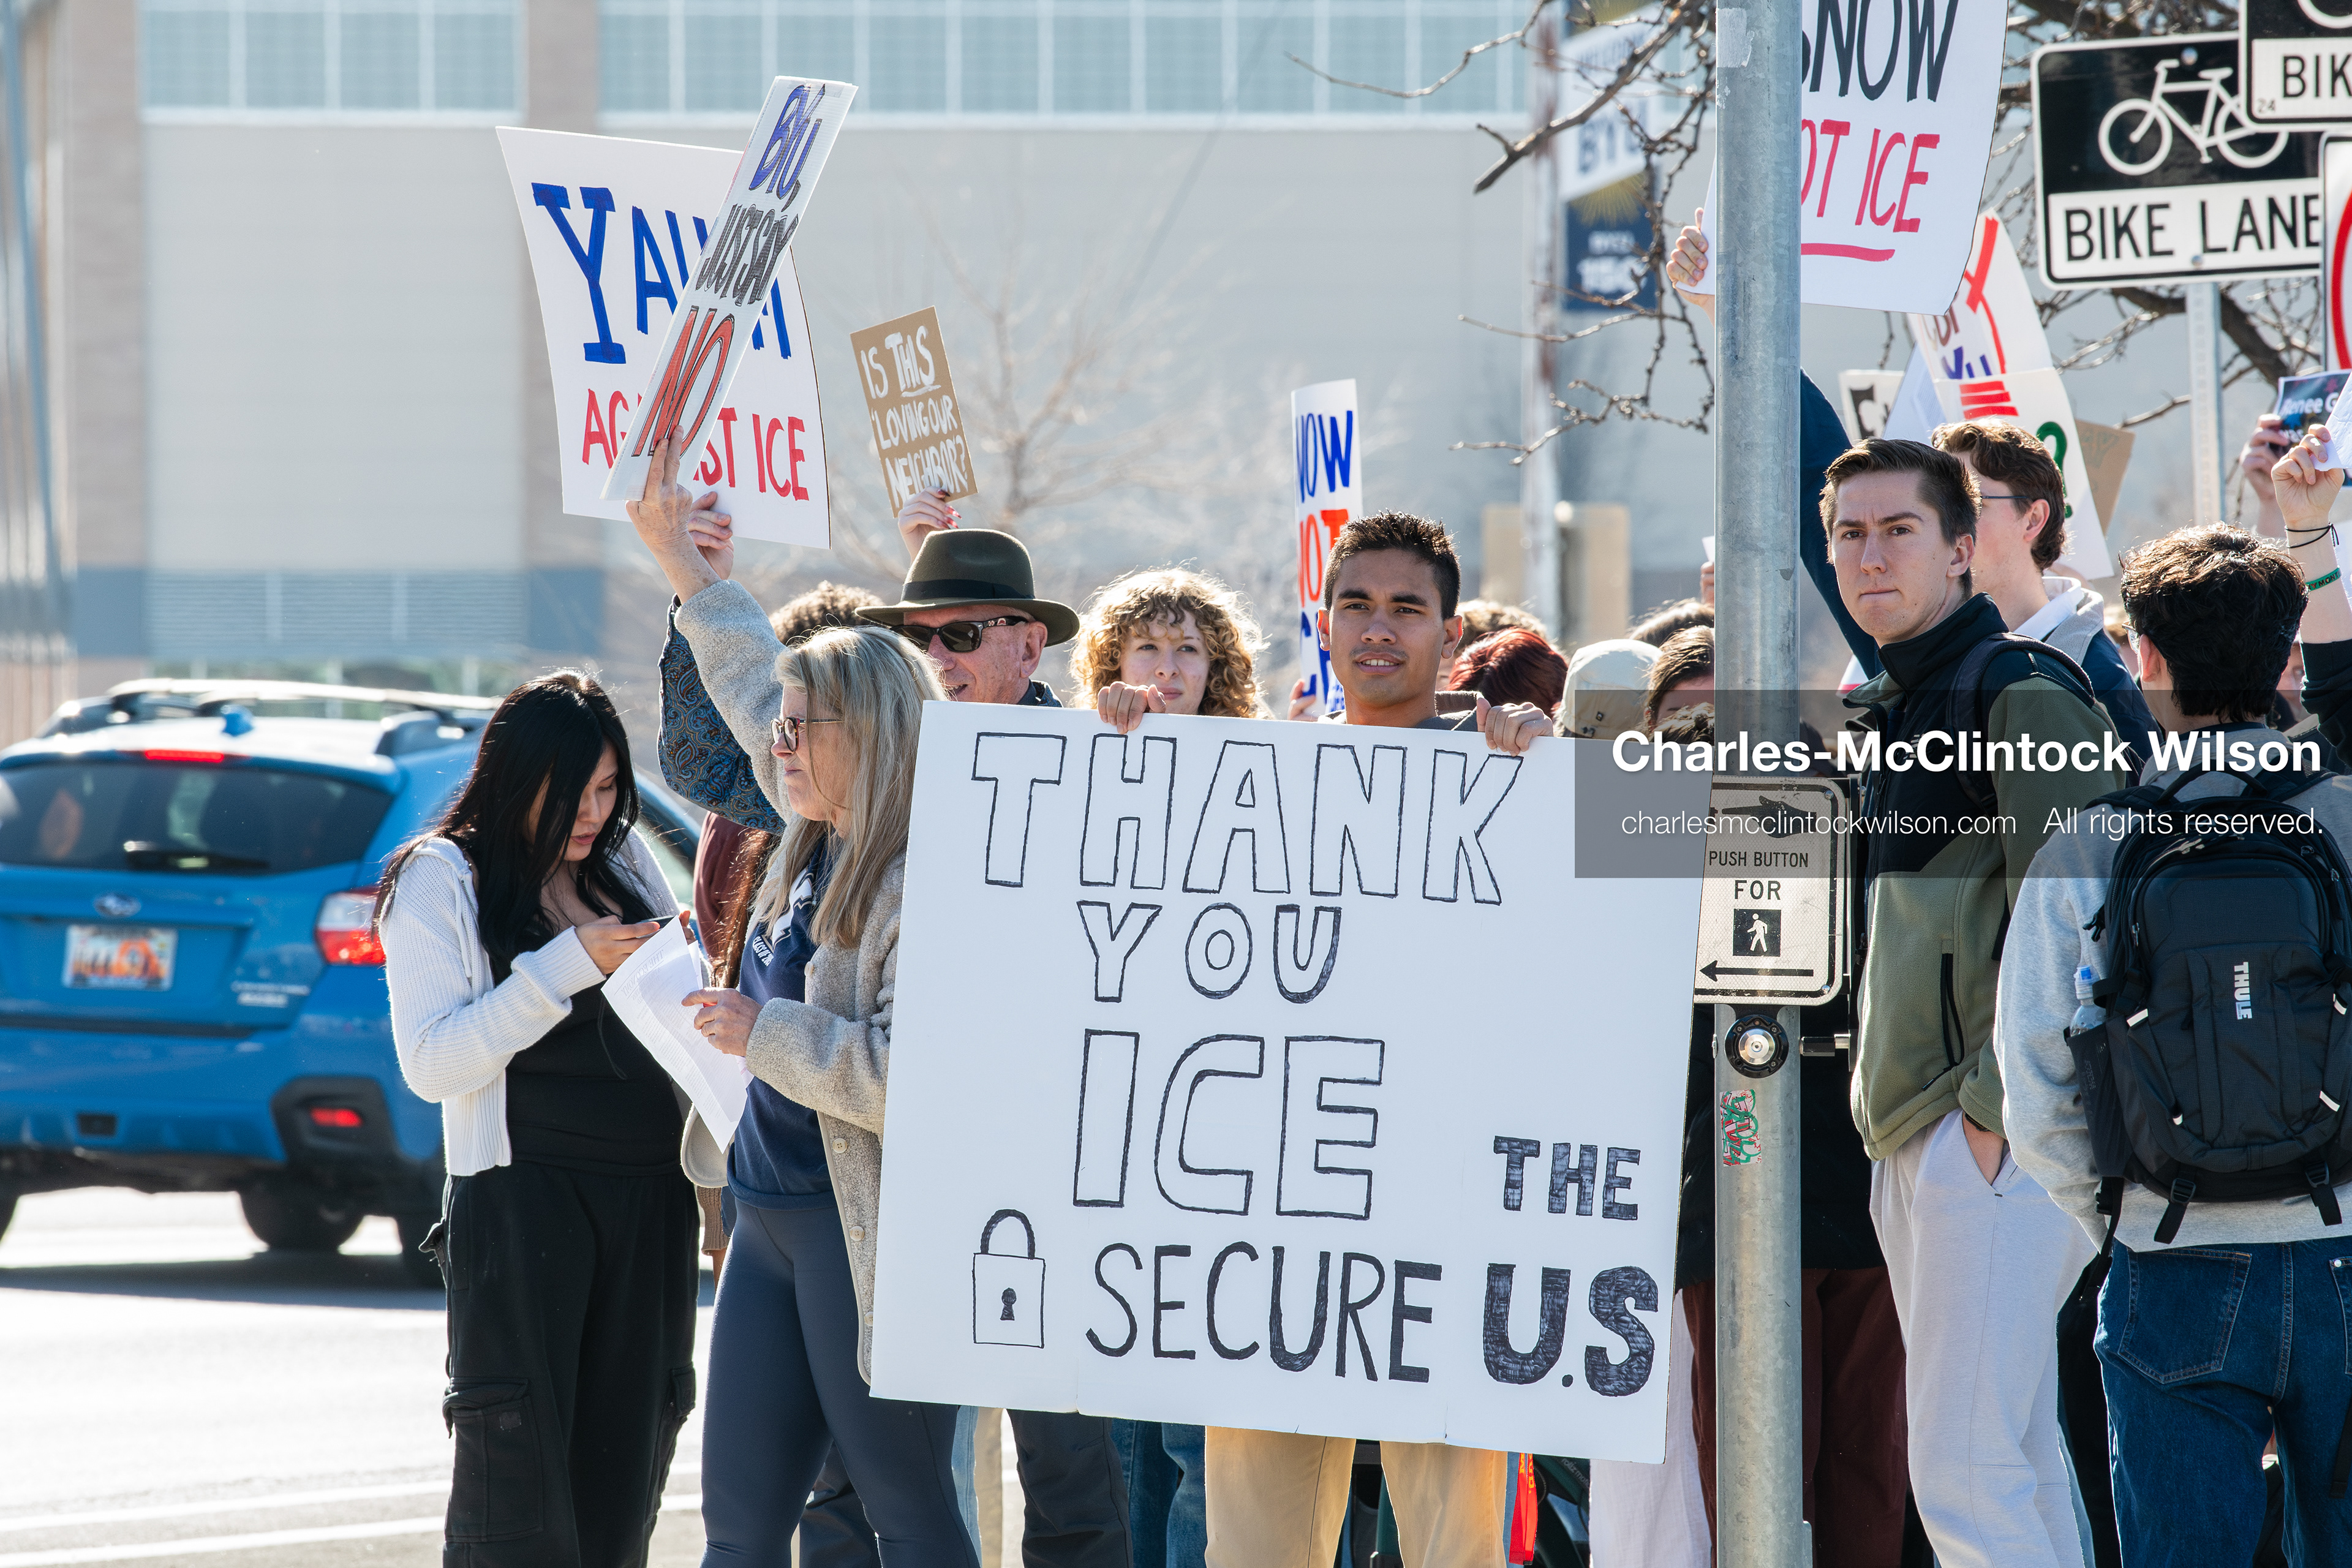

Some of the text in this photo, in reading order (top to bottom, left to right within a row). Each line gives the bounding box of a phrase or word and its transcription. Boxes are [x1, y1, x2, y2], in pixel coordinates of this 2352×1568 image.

[1802, 0, 1958, 102] NOW
[1855, 128, 1940, 233] ICE
[2065, 194, 2320, 262] BIKE LANE
[696, 204, 799, 307] JUST SAY
[631, 305, 735, 459] NO
[861, 325, 935, 399] IS THIS
[582, 388, 809, 501] AGST ICE
[928, 395, 958, 435] OUR
[1296, 410, 1353, 503] NOW
[971, 732, 1525, 905] THANK
[1709, 851, 1809, 868] PUSH BUTTON
[1734, 880, 1781, 900] FOR
[1076, 900, 1343, 1004] YOU
[2234, 961, 2253, 1020] THULE
[1073, 1028, 1385, 1220] ICE
[1493, 1136, 1641, 1221] THE
[1085, 1240, 1659, 1398] SECURE U.S
